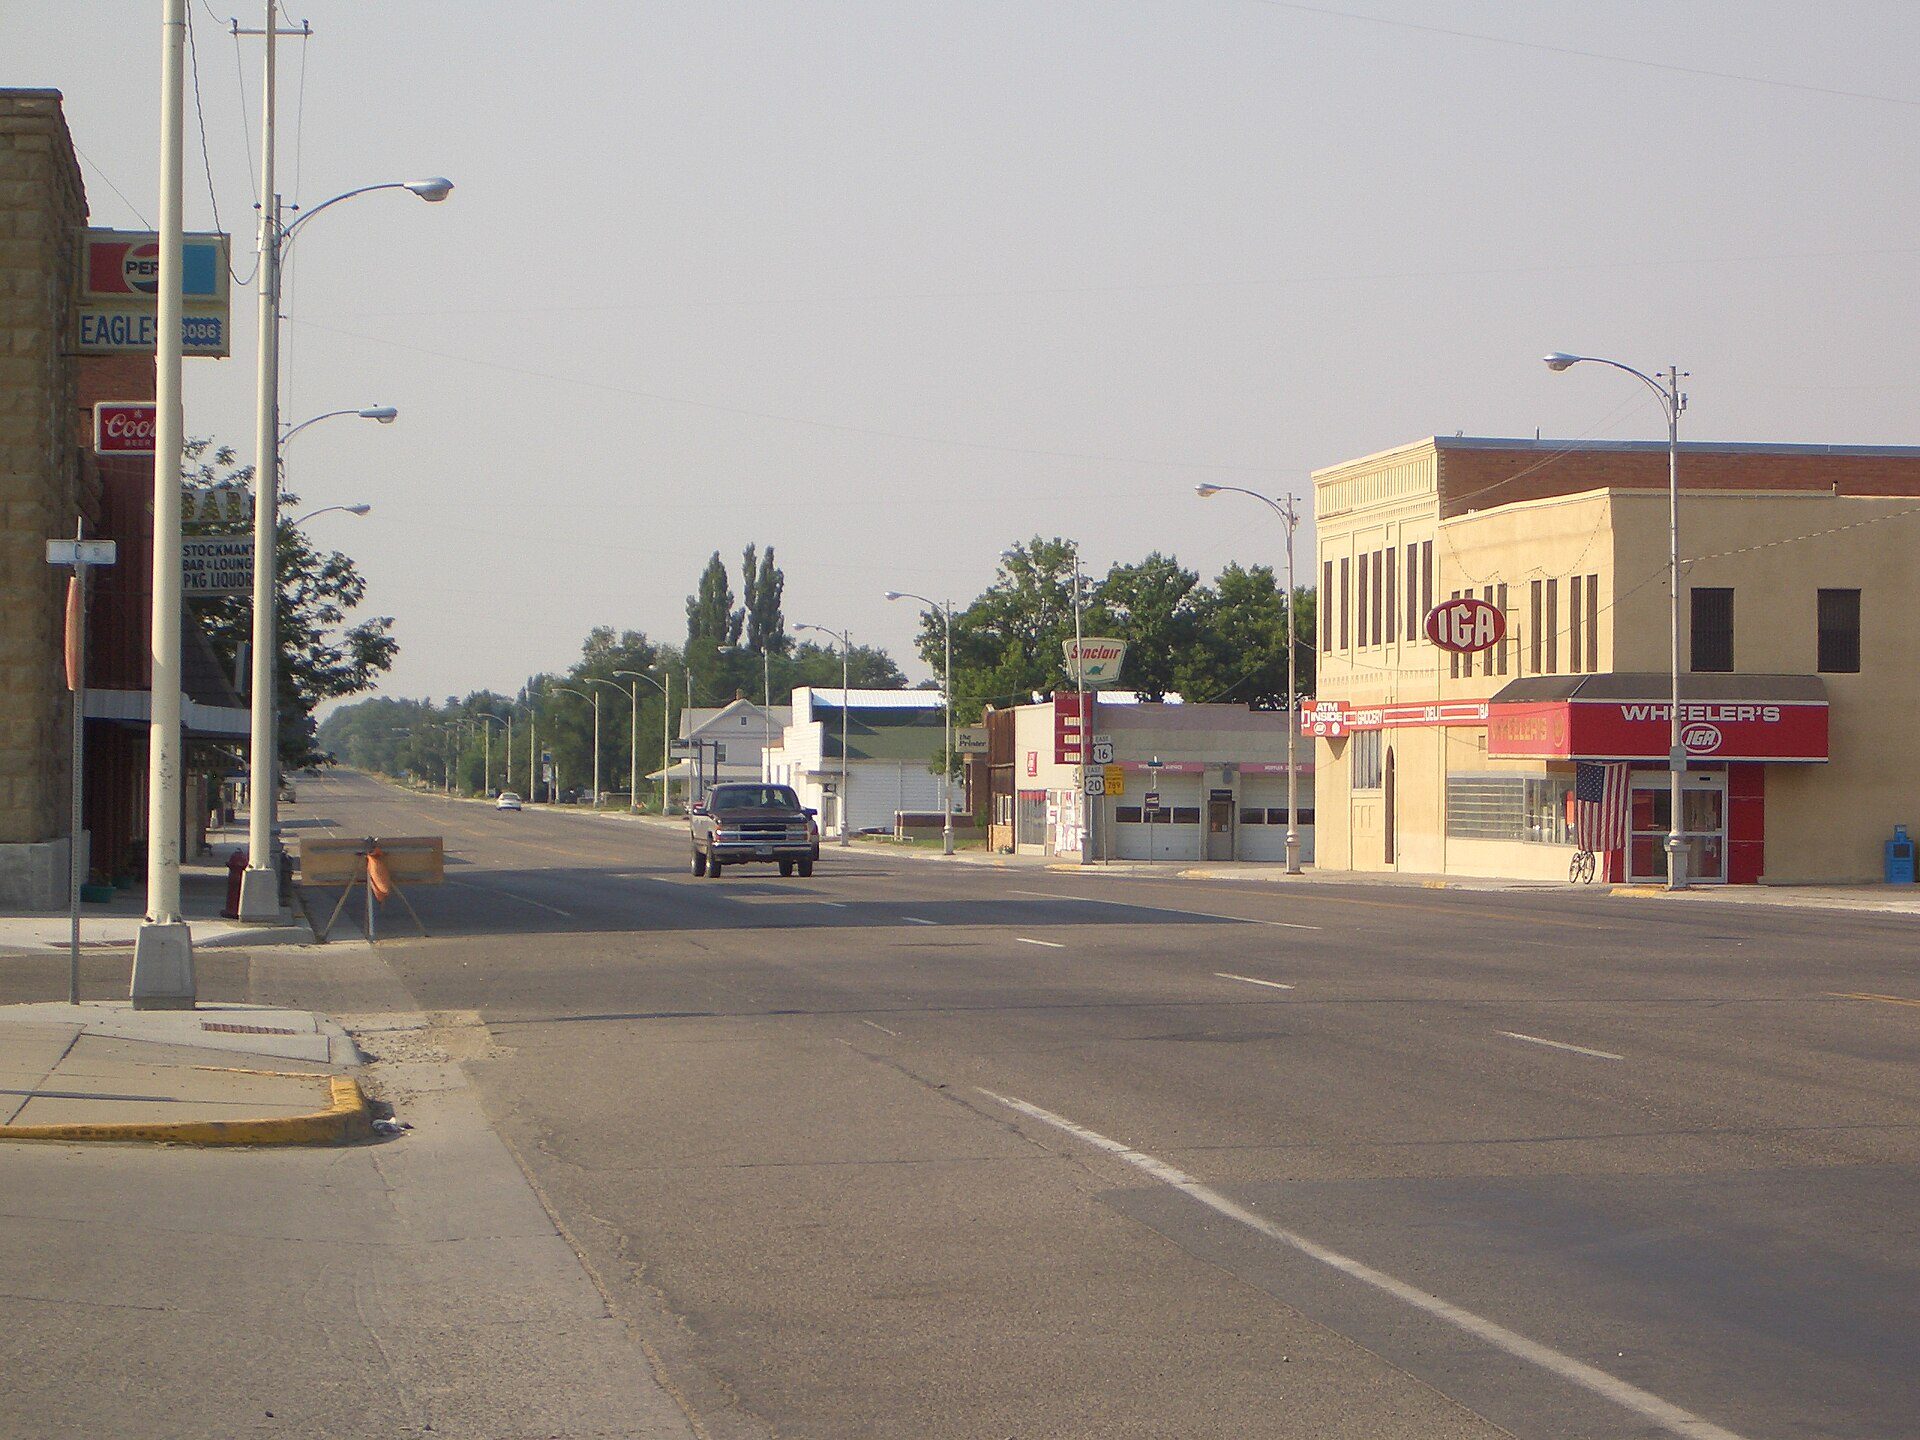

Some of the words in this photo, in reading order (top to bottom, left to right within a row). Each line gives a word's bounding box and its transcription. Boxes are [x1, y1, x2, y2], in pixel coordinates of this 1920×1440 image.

[126, 260, 158, 275] PEP
[104, 413, 155, 438] Coo
[182, 559, 205, 572] BAR
[214, 558, 252, 571] LOUNG
[184, 573, 207, 589] PKG
[1438, 603, 1495, 648] IGA
[1316, 702, 1338, 712] ATM
[1426, 705, 1439, 722] DELI
[1311, 711, 1342, 722] INSIDE
[1357, 709, 1382, 725] GROCERY
[1685, 730, 1716, 746] IGA
[1098, 748, 1108, 759] 16
[1088, 780, 1101, 791] 20
